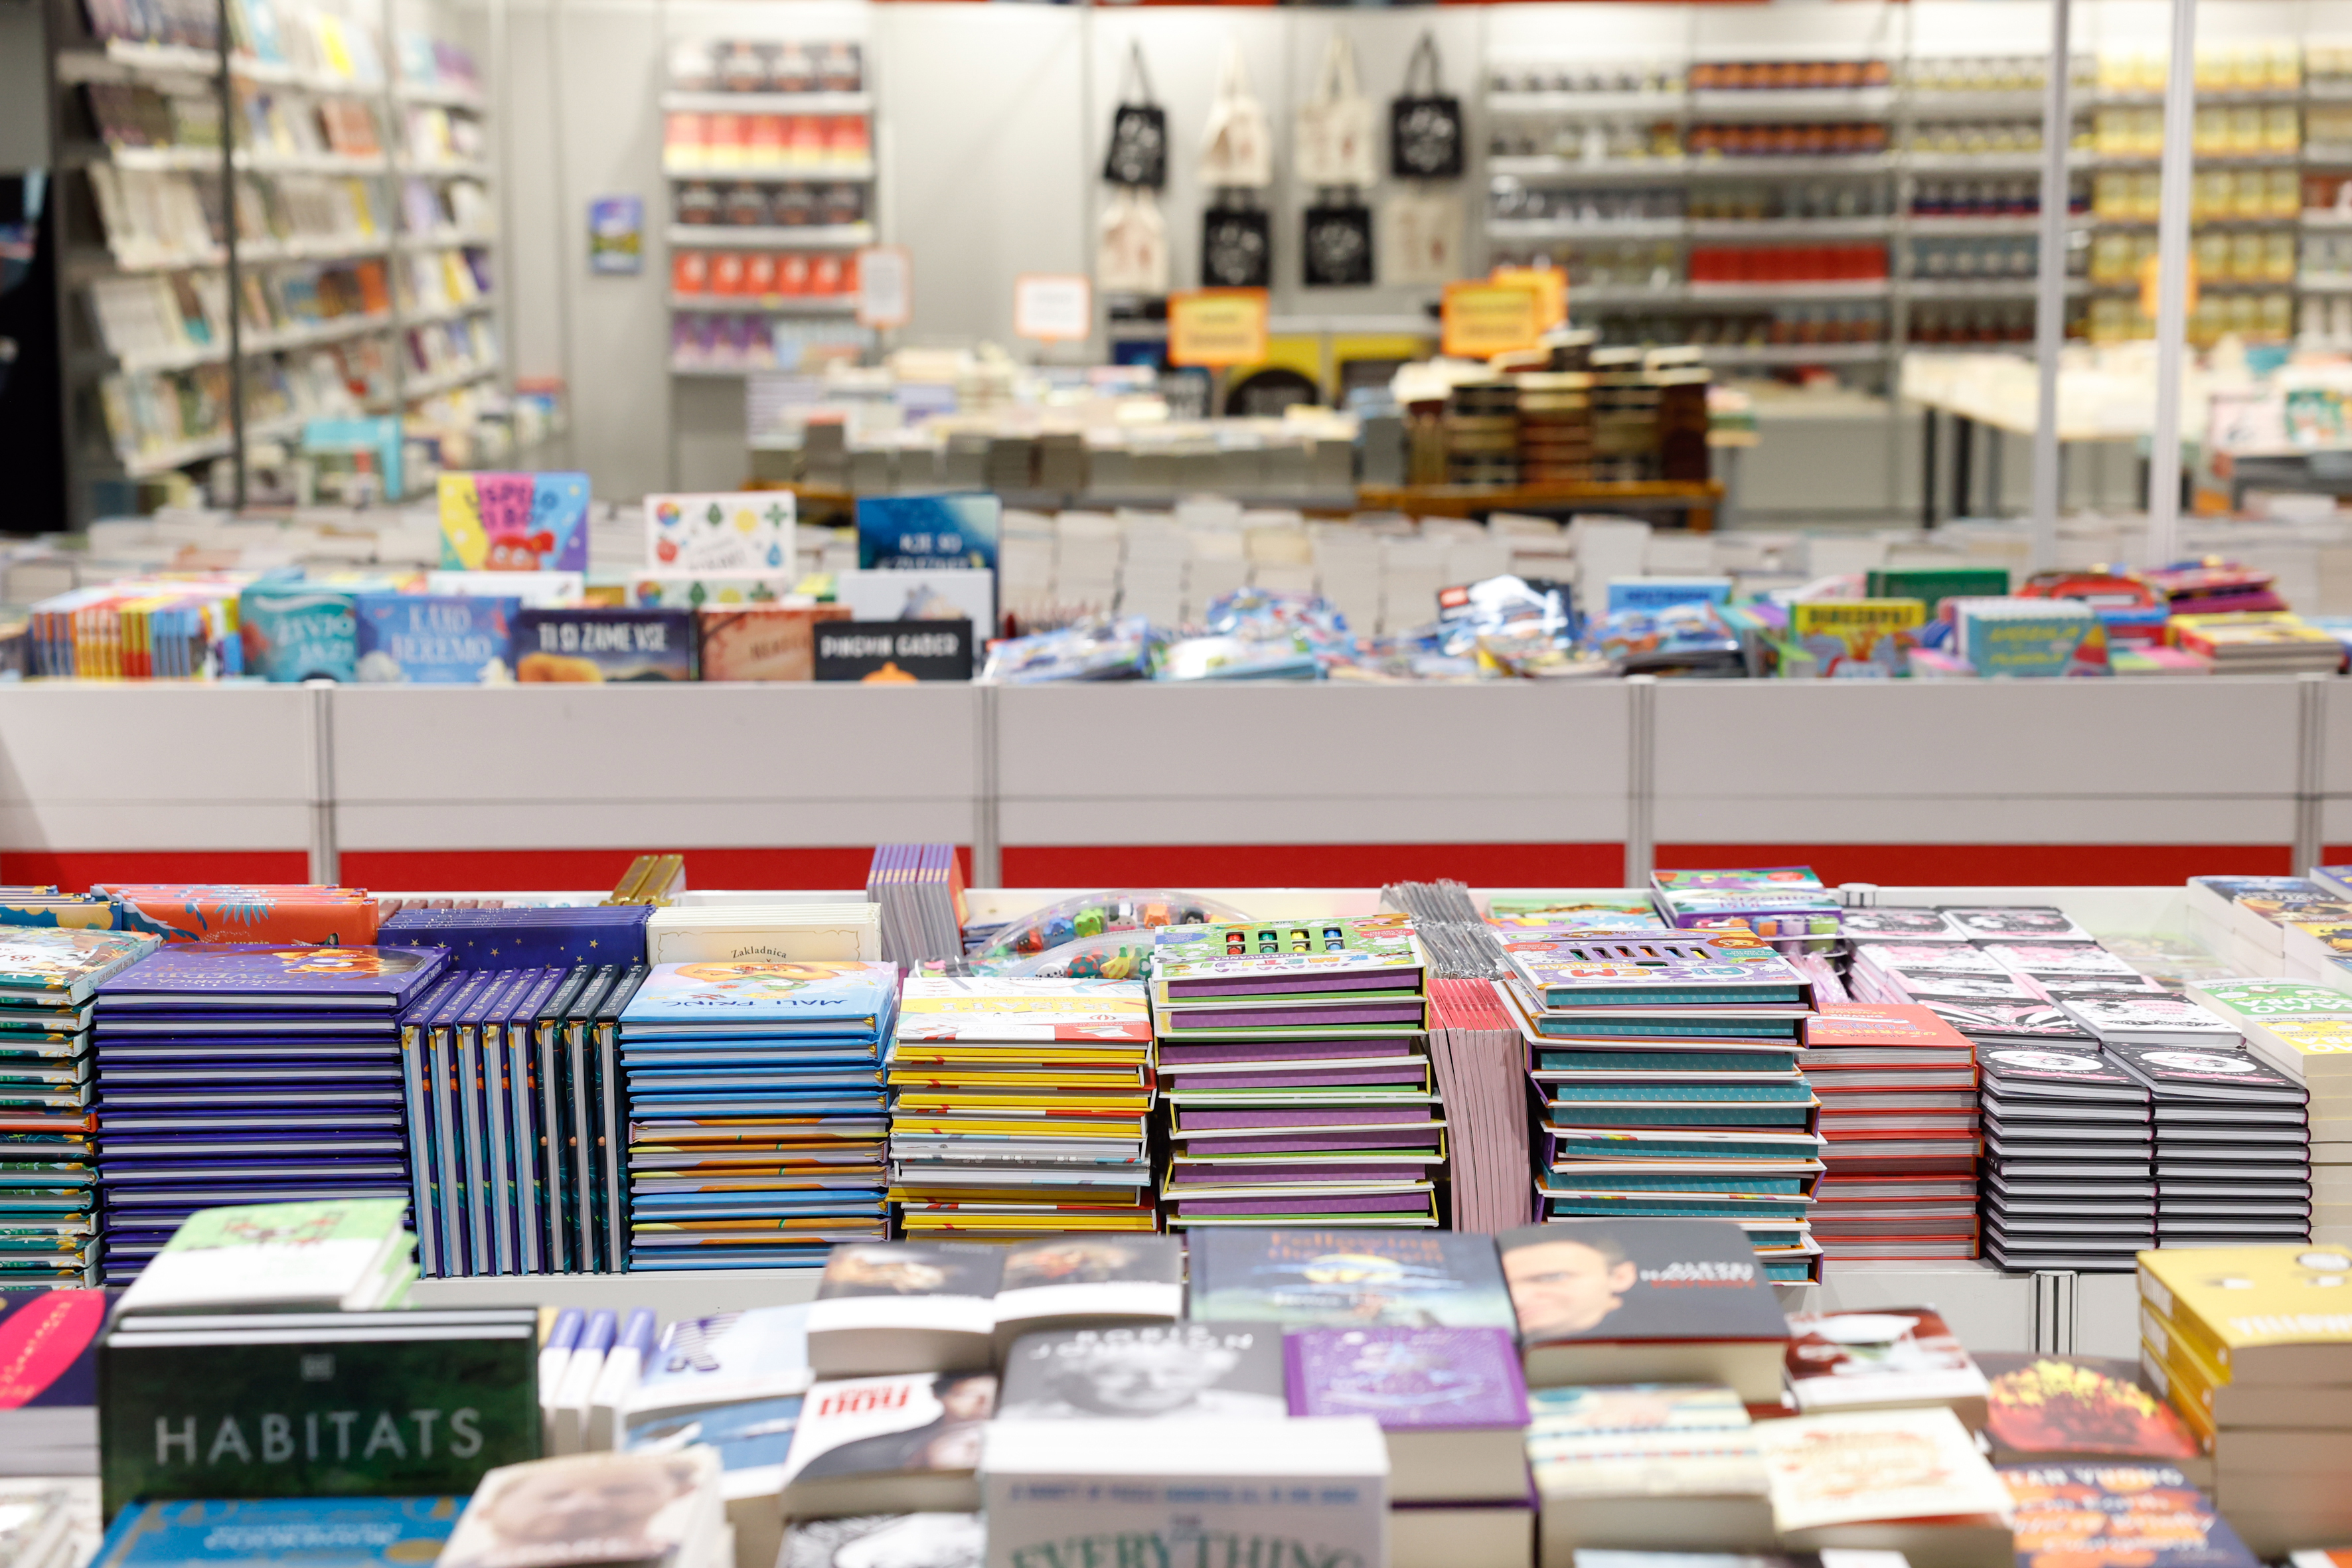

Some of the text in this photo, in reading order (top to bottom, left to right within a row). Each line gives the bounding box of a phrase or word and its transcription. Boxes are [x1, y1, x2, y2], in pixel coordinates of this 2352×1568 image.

[731, 946, 787, 959] Zakladnica
[1200, 955, 1370, 969] KMETIJI
[1571, 967, 1746, 979] RIŠEM
[155, 1407, 484, 1466] HABITATS
